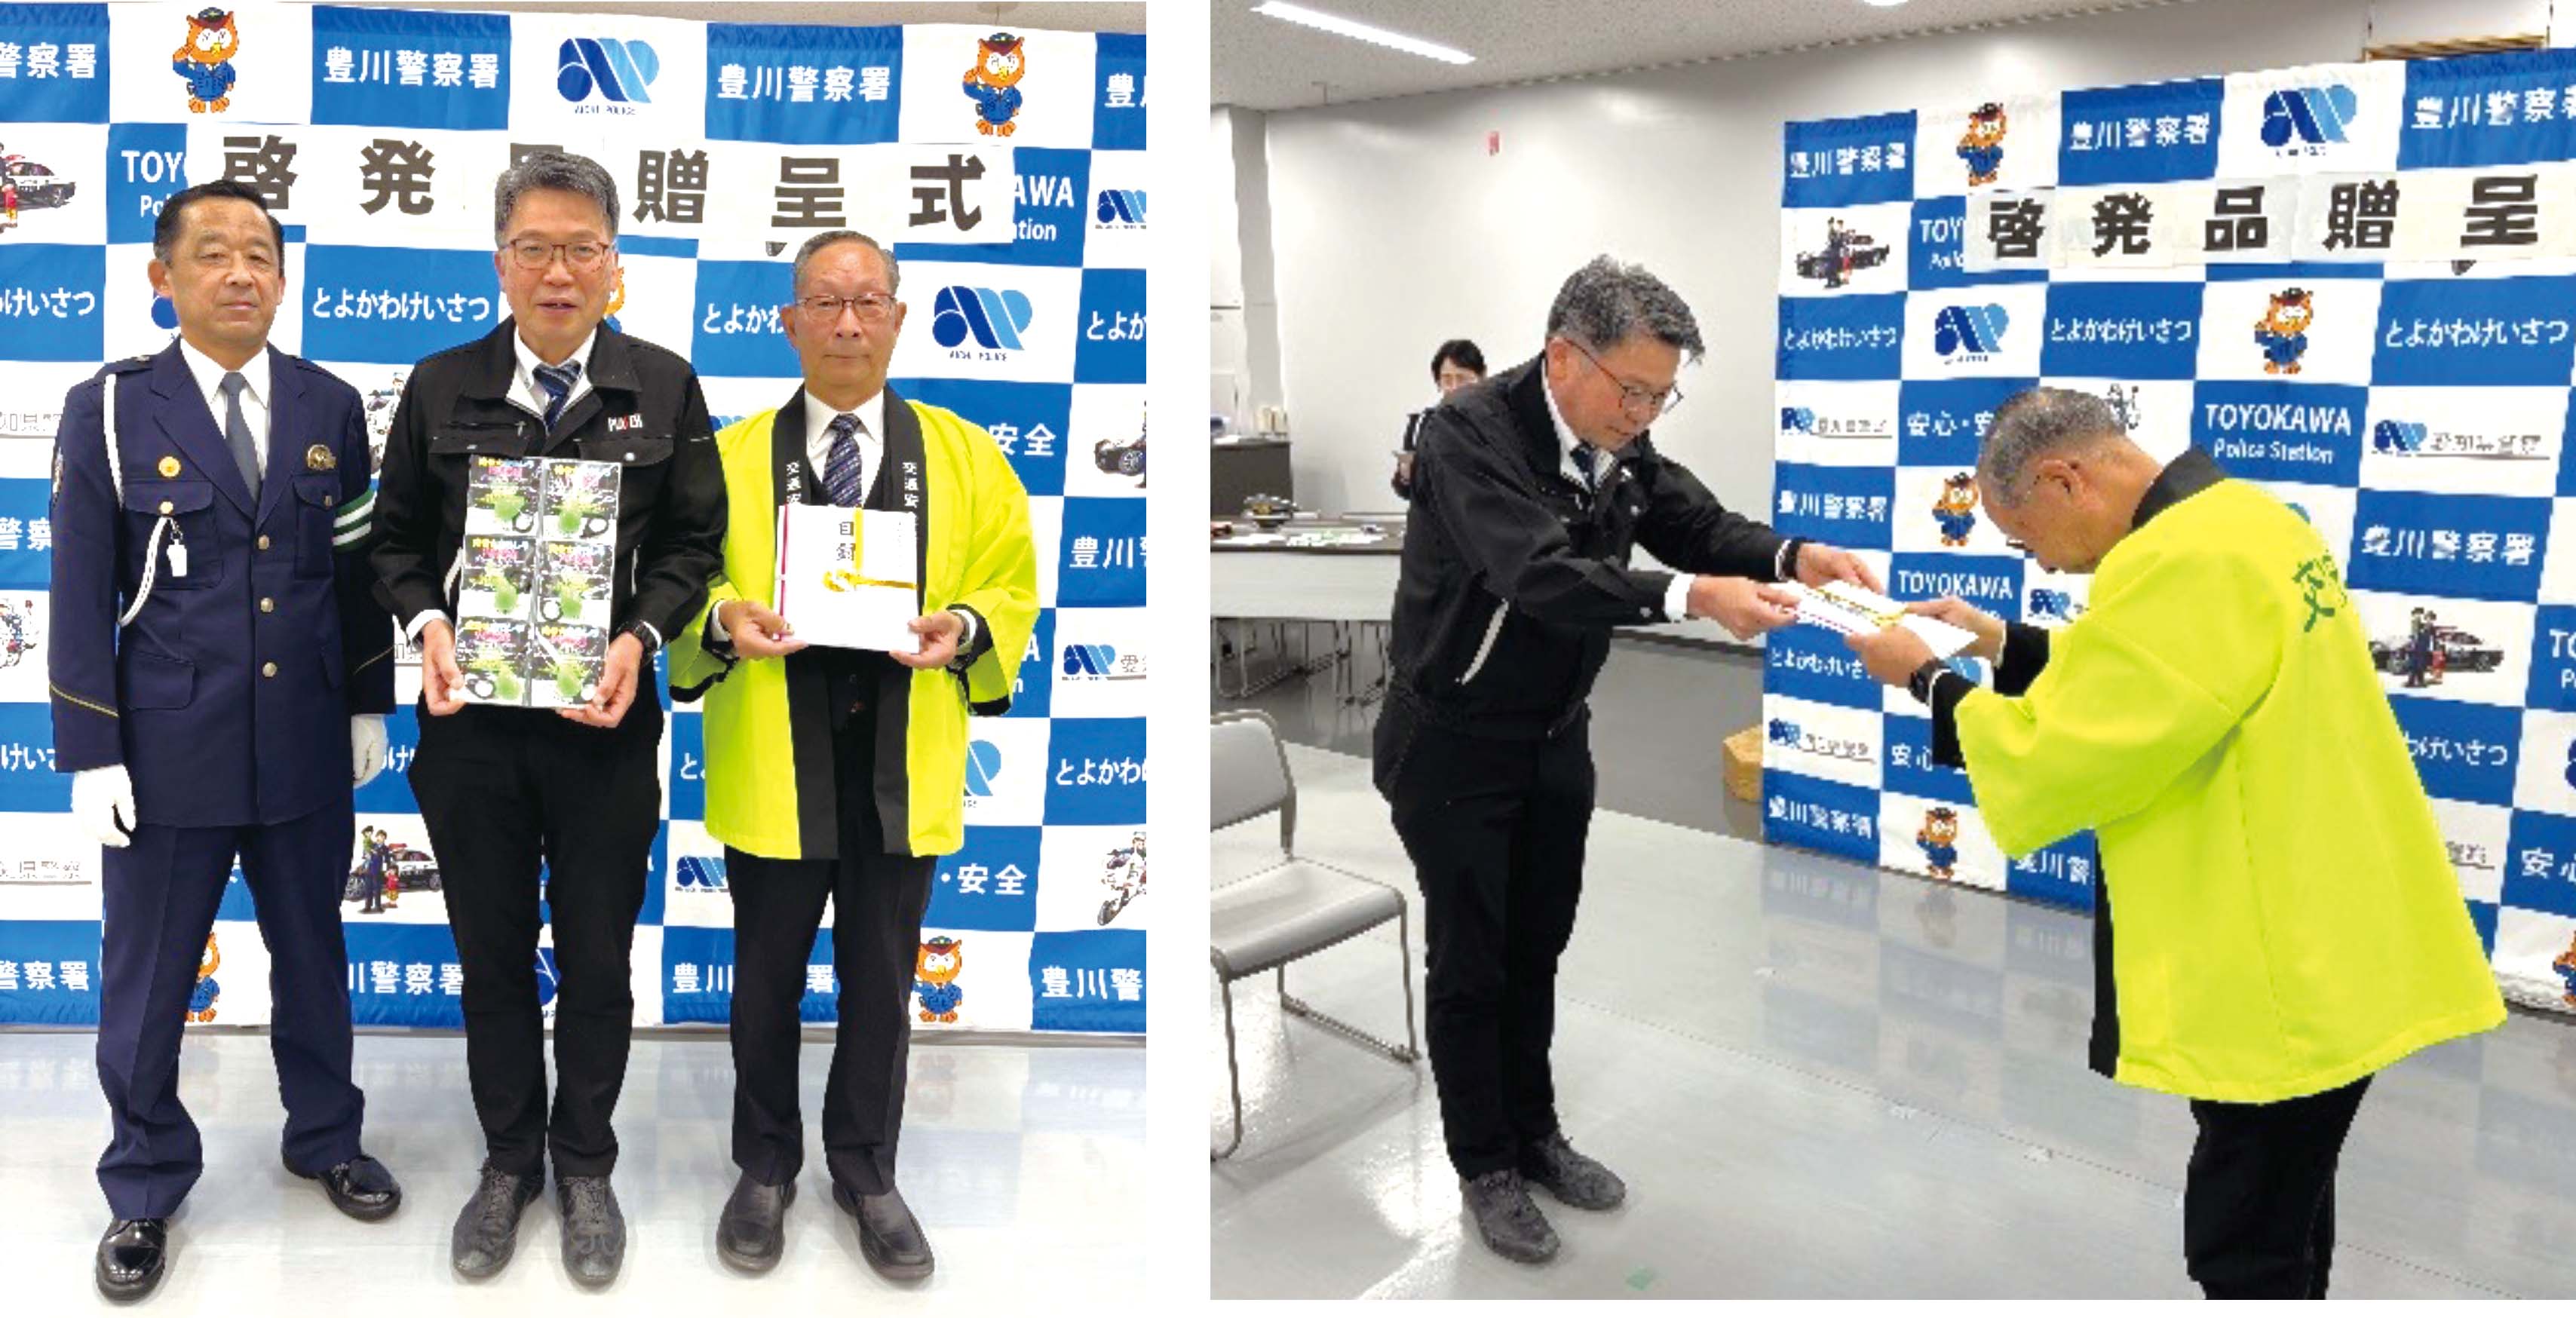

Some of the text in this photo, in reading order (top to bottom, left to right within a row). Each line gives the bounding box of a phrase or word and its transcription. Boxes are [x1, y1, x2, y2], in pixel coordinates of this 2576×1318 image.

[324, 46, 499, 88] 豊川警察署
[717, 64, 891, 103] 豊川警察署
[121, 150, 187, 183] TOY
[223, 136, 986, 231] 啓発贈呈式
[1919, 216, 1964, 244] TOY
[0, 287, 95, 318] けいさつ
[312, 287, 489, 323] とよかわけいさつ
[2386, 318, 2569, 347] とよかわけいさつ
[2205, 404, 2351, 436] TOYOKAWA
[1069, 537, 1146, 569] 豊川
[1897, 571, 2013, 599] TOYOKAWA
[1056, 756, 1146, 786] とよかわ
[1041, 966, 1143, 1001] 豊川警
